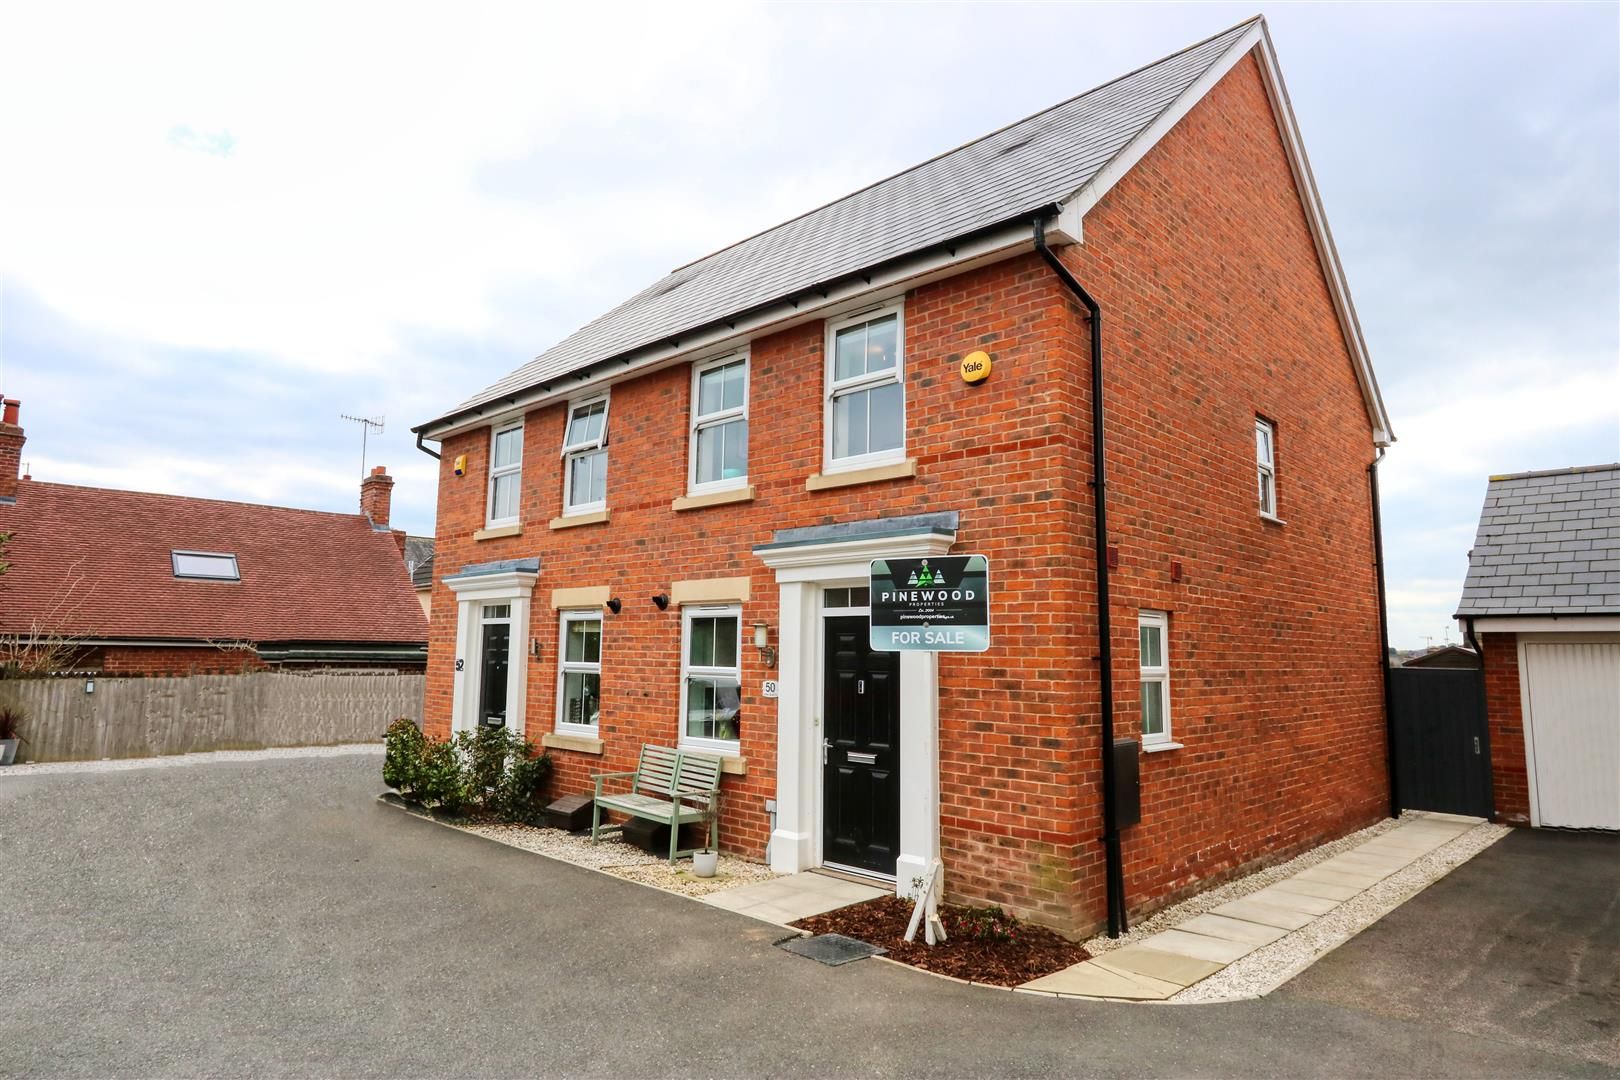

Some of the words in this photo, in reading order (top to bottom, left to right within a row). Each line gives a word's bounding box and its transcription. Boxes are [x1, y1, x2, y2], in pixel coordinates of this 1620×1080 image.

[963, 361, 983, 373] Yale
[881, 590, 975, 602] PINEWOOD
[892, 632, 920, 644] FOR
[925, 632, 965, 644] SALE
[456, 659, 464, 671] 52
[766, 682, 775, 692] 50
